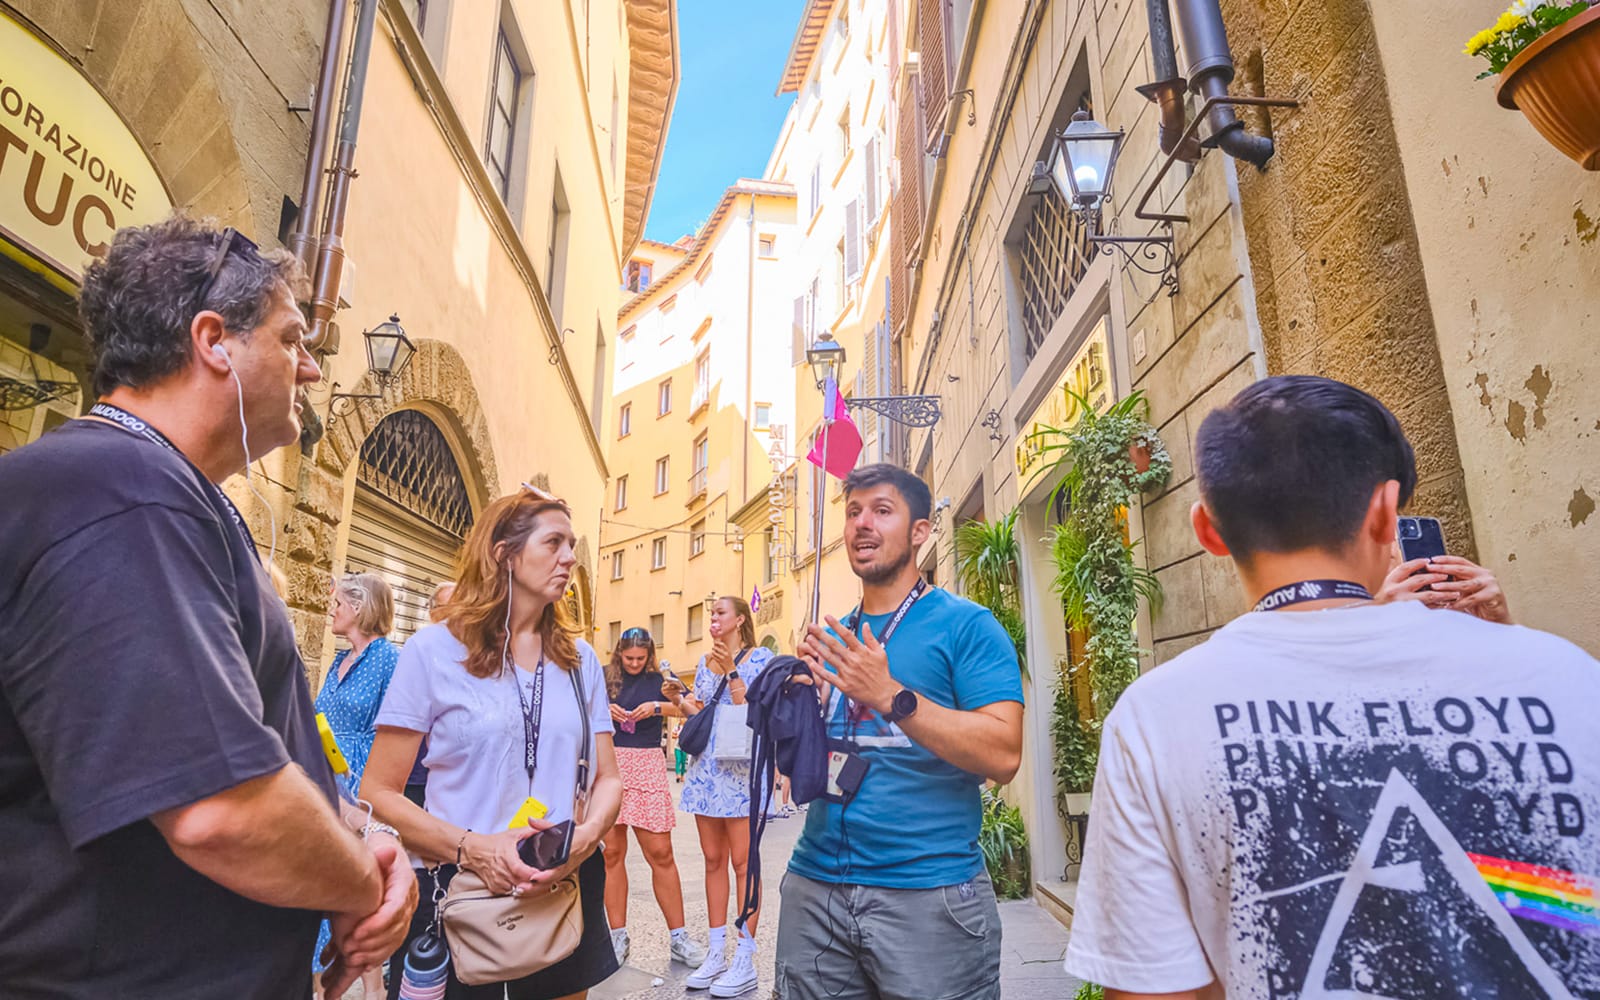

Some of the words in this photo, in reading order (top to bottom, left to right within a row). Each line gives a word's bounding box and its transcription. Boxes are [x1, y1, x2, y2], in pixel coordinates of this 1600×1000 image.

[0, 80, 137, 211] ORAZIONE
[1214, 700, 1346, 738] PINK
[1363, 697, 1555, 737] FLOYD
